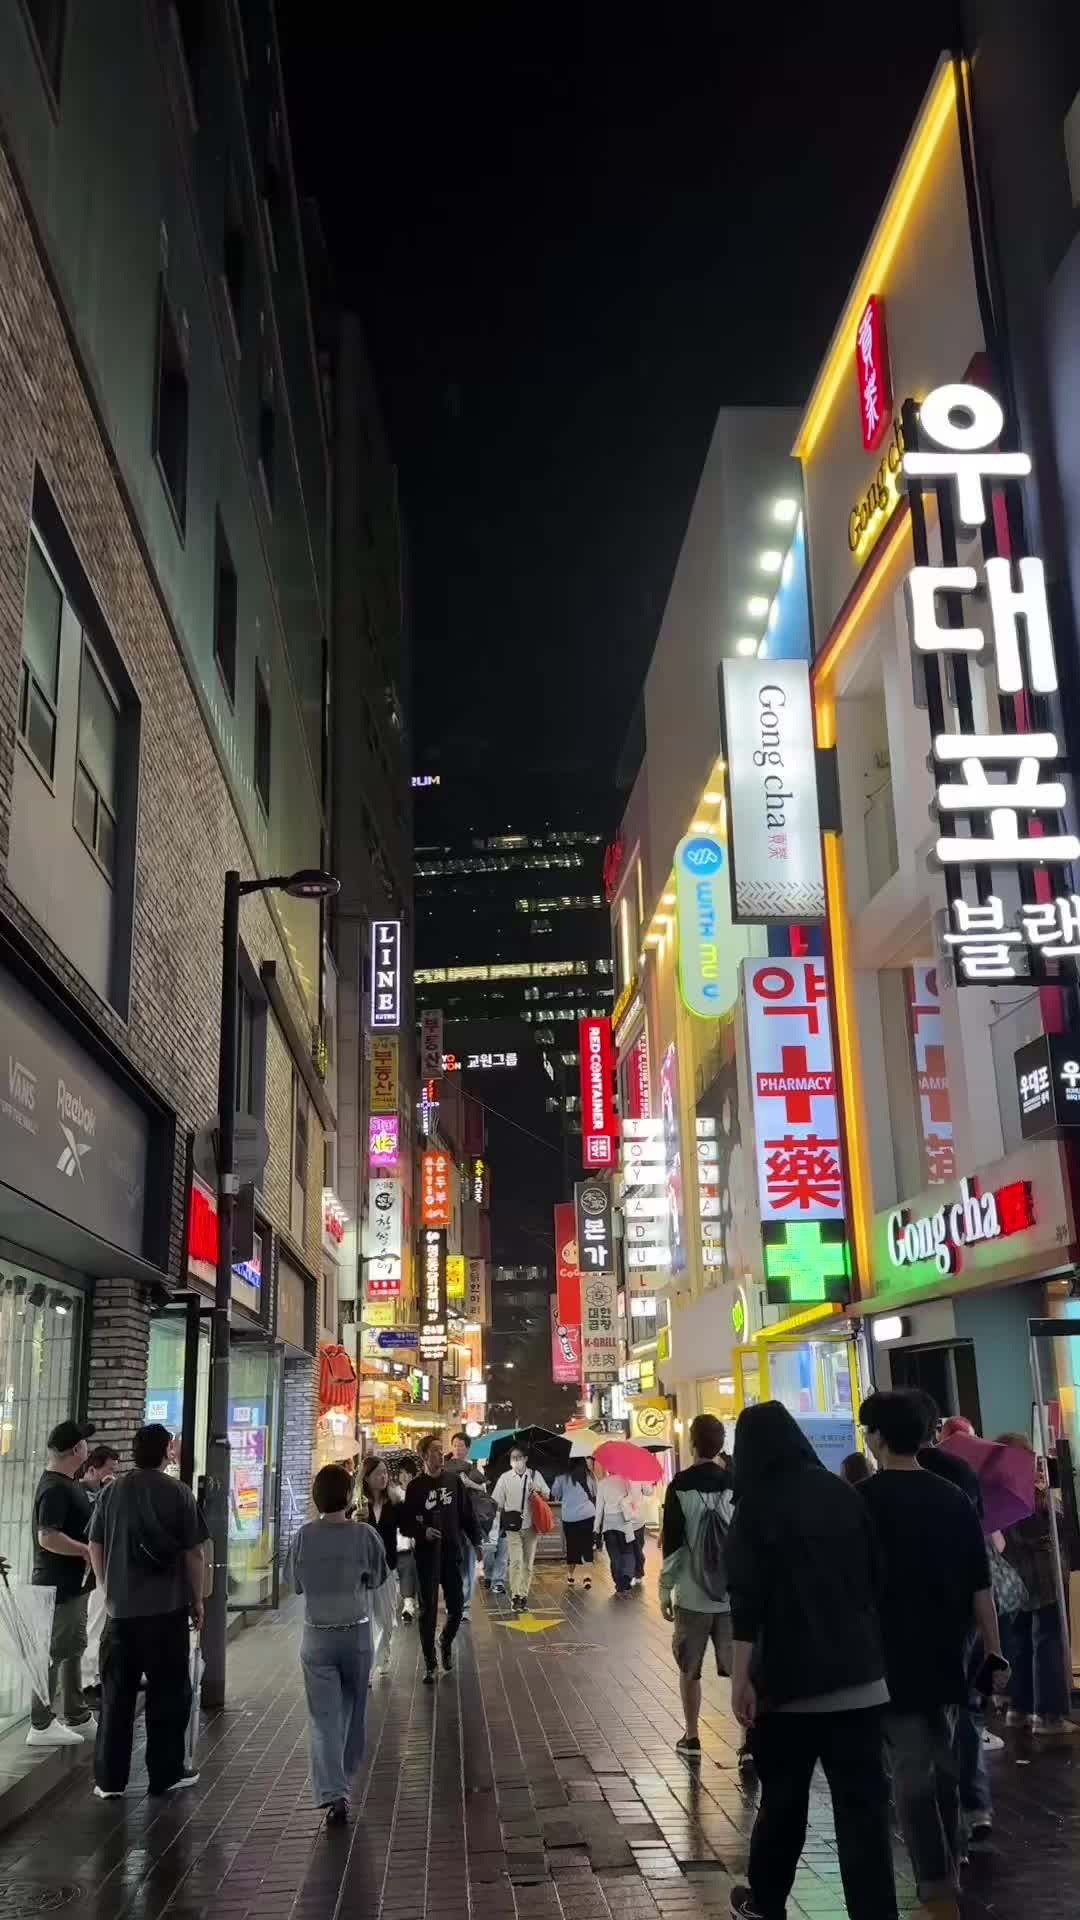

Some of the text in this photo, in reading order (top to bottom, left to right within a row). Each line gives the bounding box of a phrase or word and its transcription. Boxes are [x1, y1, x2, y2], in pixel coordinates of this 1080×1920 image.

[902, 383, 1080, 861] 우대포
[752, 684, 793, 830] Gong cha
[377, 926, 395, 1011] LINE
[752, 962, 828, 1035] 약
[375, 1050, 395, 1097] 부동산
[467, 1052, 518, 1069] 교원그룹
[590, 1053, 605, 1131] CONTAINER
[759, 1076, 832, 1092] PHARMACY
[1020, 1066, 1050, 1101] 우대포
[57, 1079, 97, 1136] Reebok
[631, 1121, 642, 1178] TOY
[763, 1134, 842, 1210] 藥
[634, 1200, 648, 1312] ADULT
[887, 1207, 950, 1275] Gong
[949, 1176, 1001, 1247] cha
[584, 1337, 617, 1347] K-GRILL
